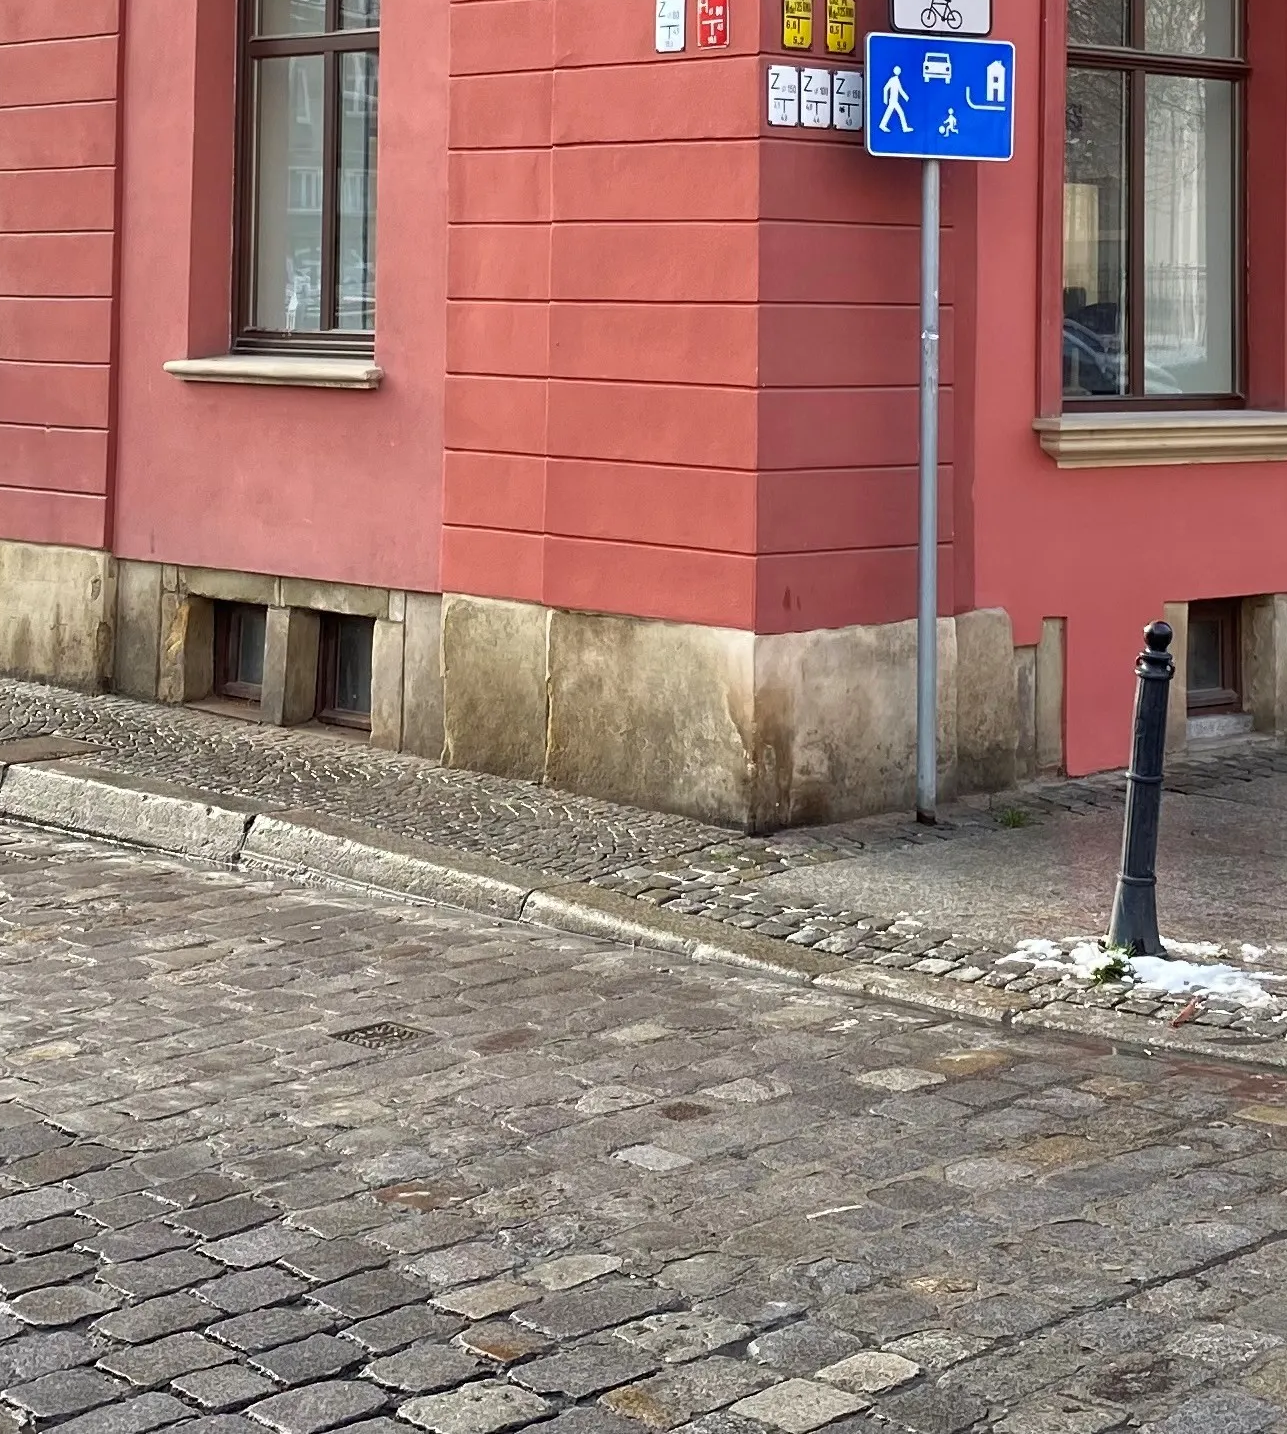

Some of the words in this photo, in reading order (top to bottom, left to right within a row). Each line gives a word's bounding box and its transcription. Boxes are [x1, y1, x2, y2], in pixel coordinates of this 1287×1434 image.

[658, 1, 666, 18] Z
[770, 72, 780, 90] Z
[803, 75, 813, 93] Z
[835, 77, 845, 95] Z
